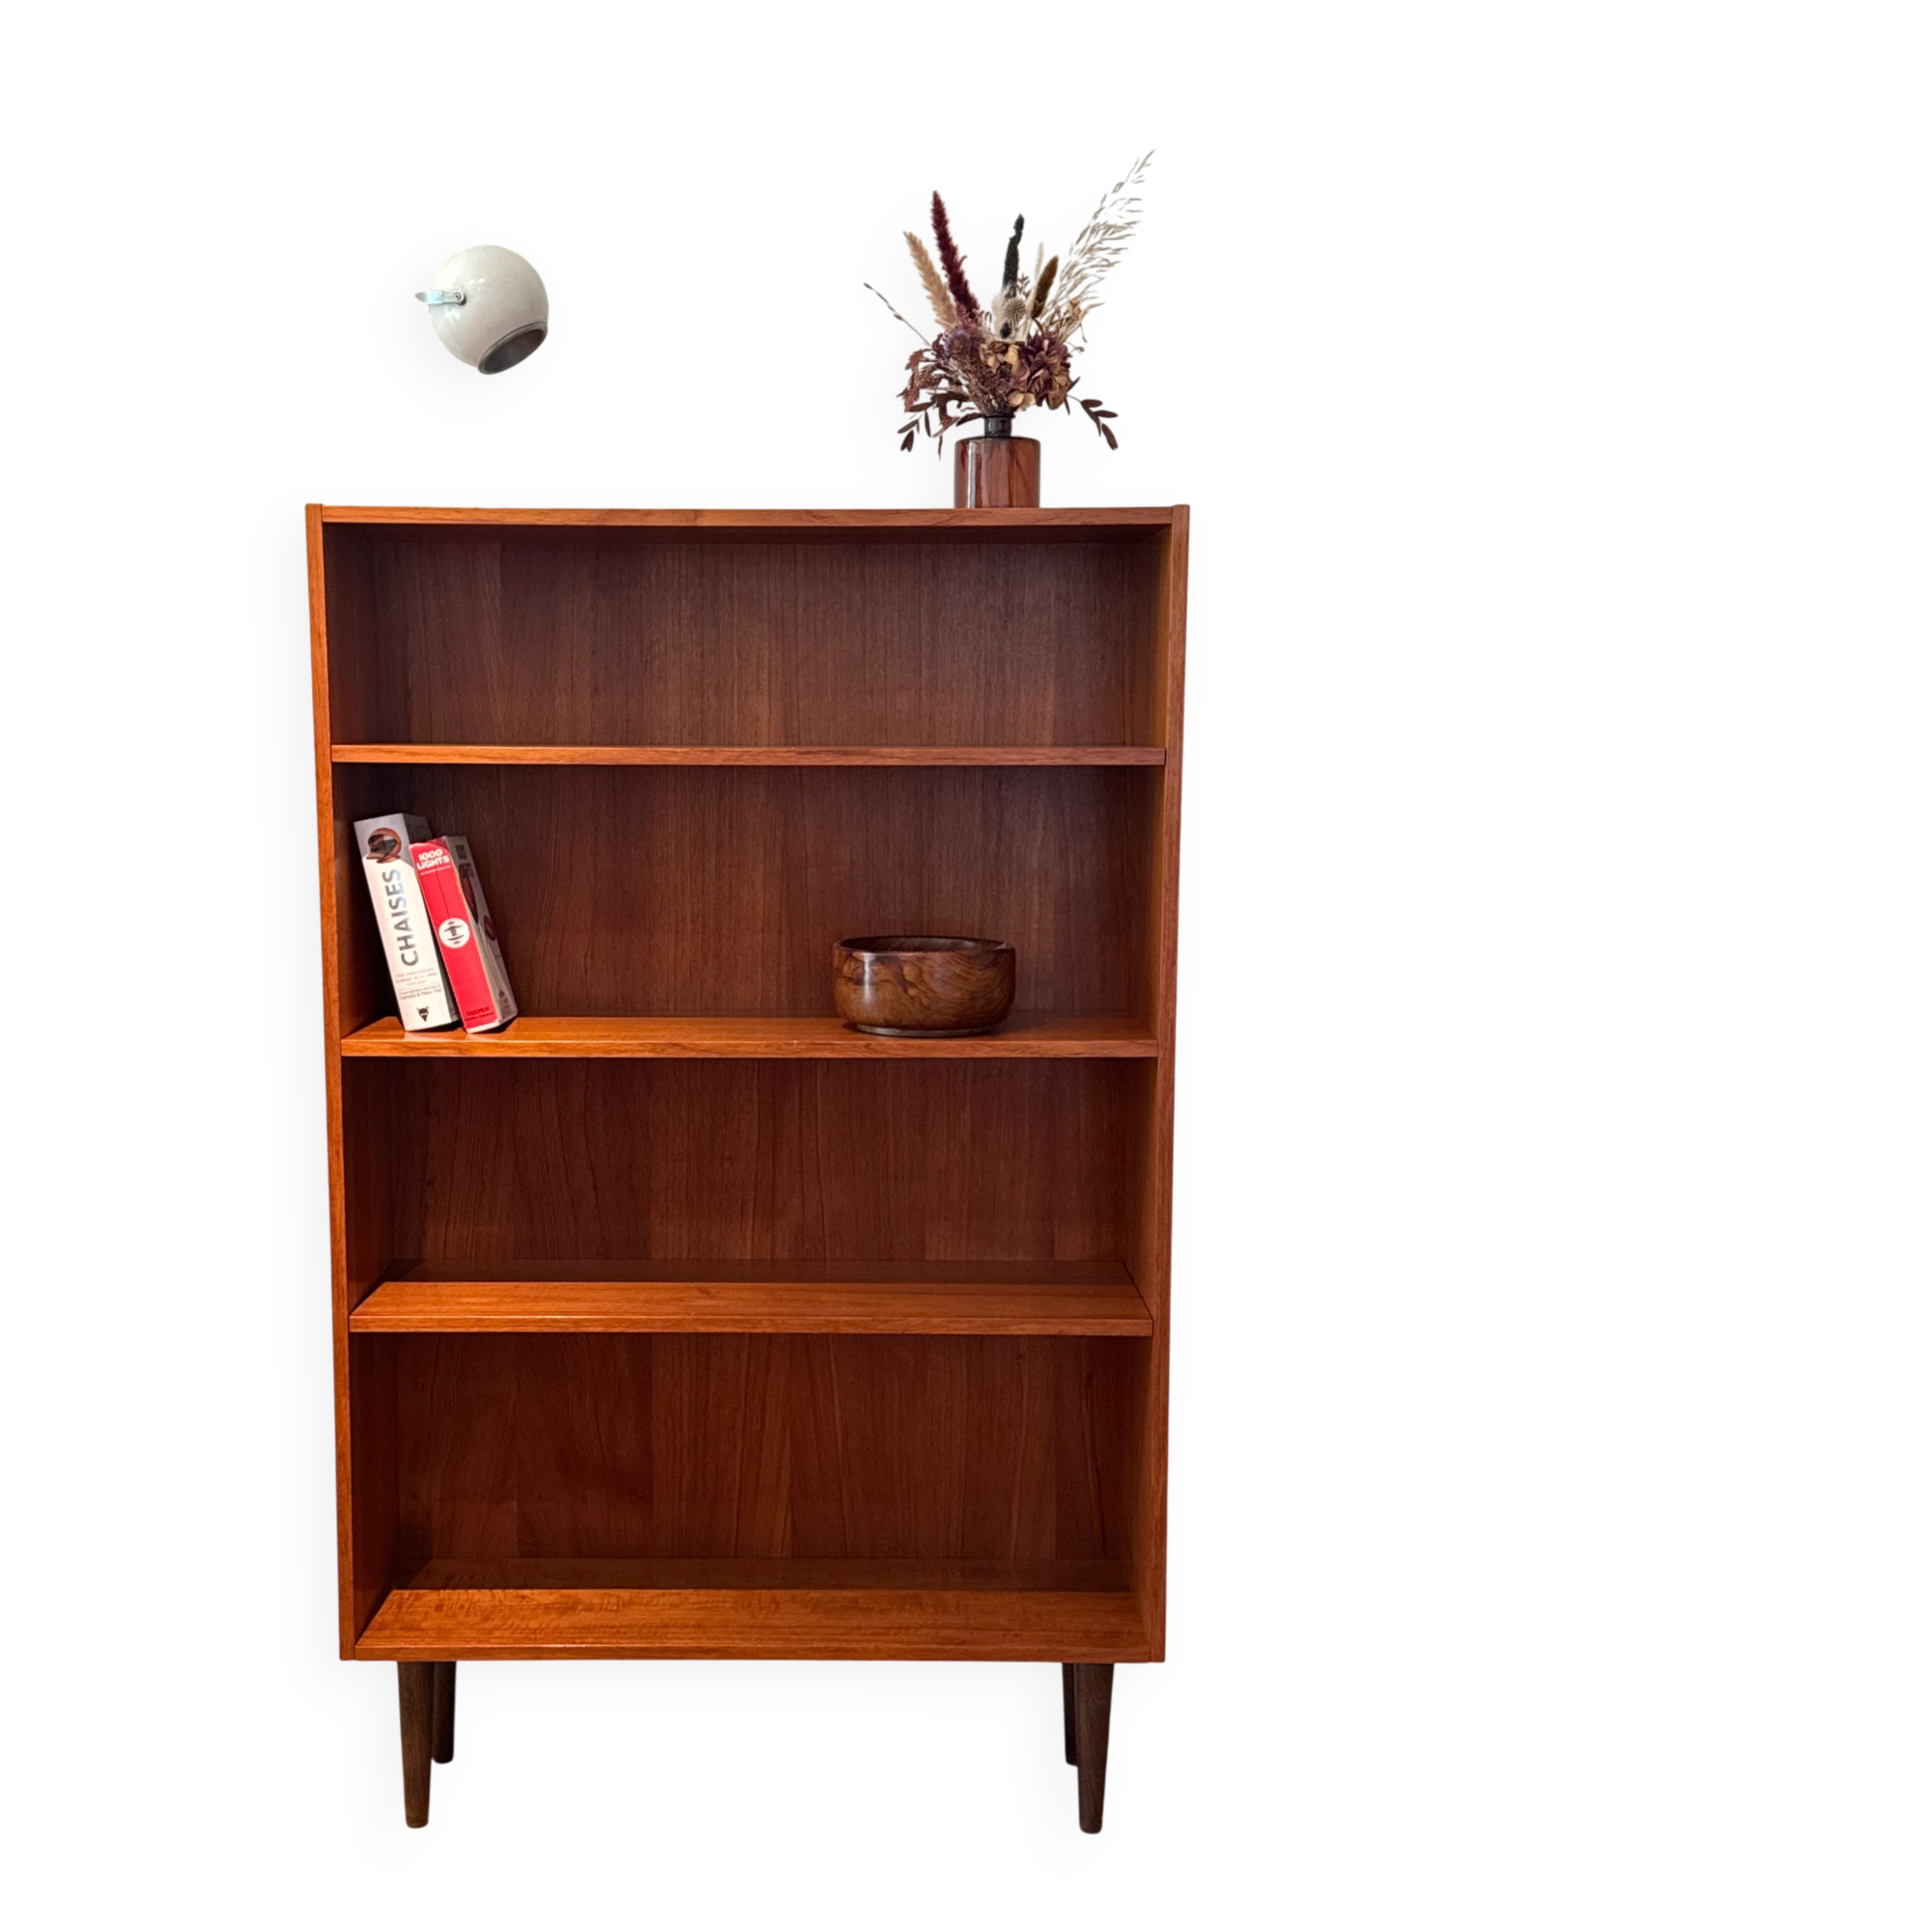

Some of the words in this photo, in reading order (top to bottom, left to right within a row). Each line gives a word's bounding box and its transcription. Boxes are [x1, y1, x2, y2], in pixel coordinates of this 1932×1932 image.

[416, 854, 450, 870] LIGHTS
[418, 848, 443, 862] 1000
[382, 868, 419, 966] CHAISES
